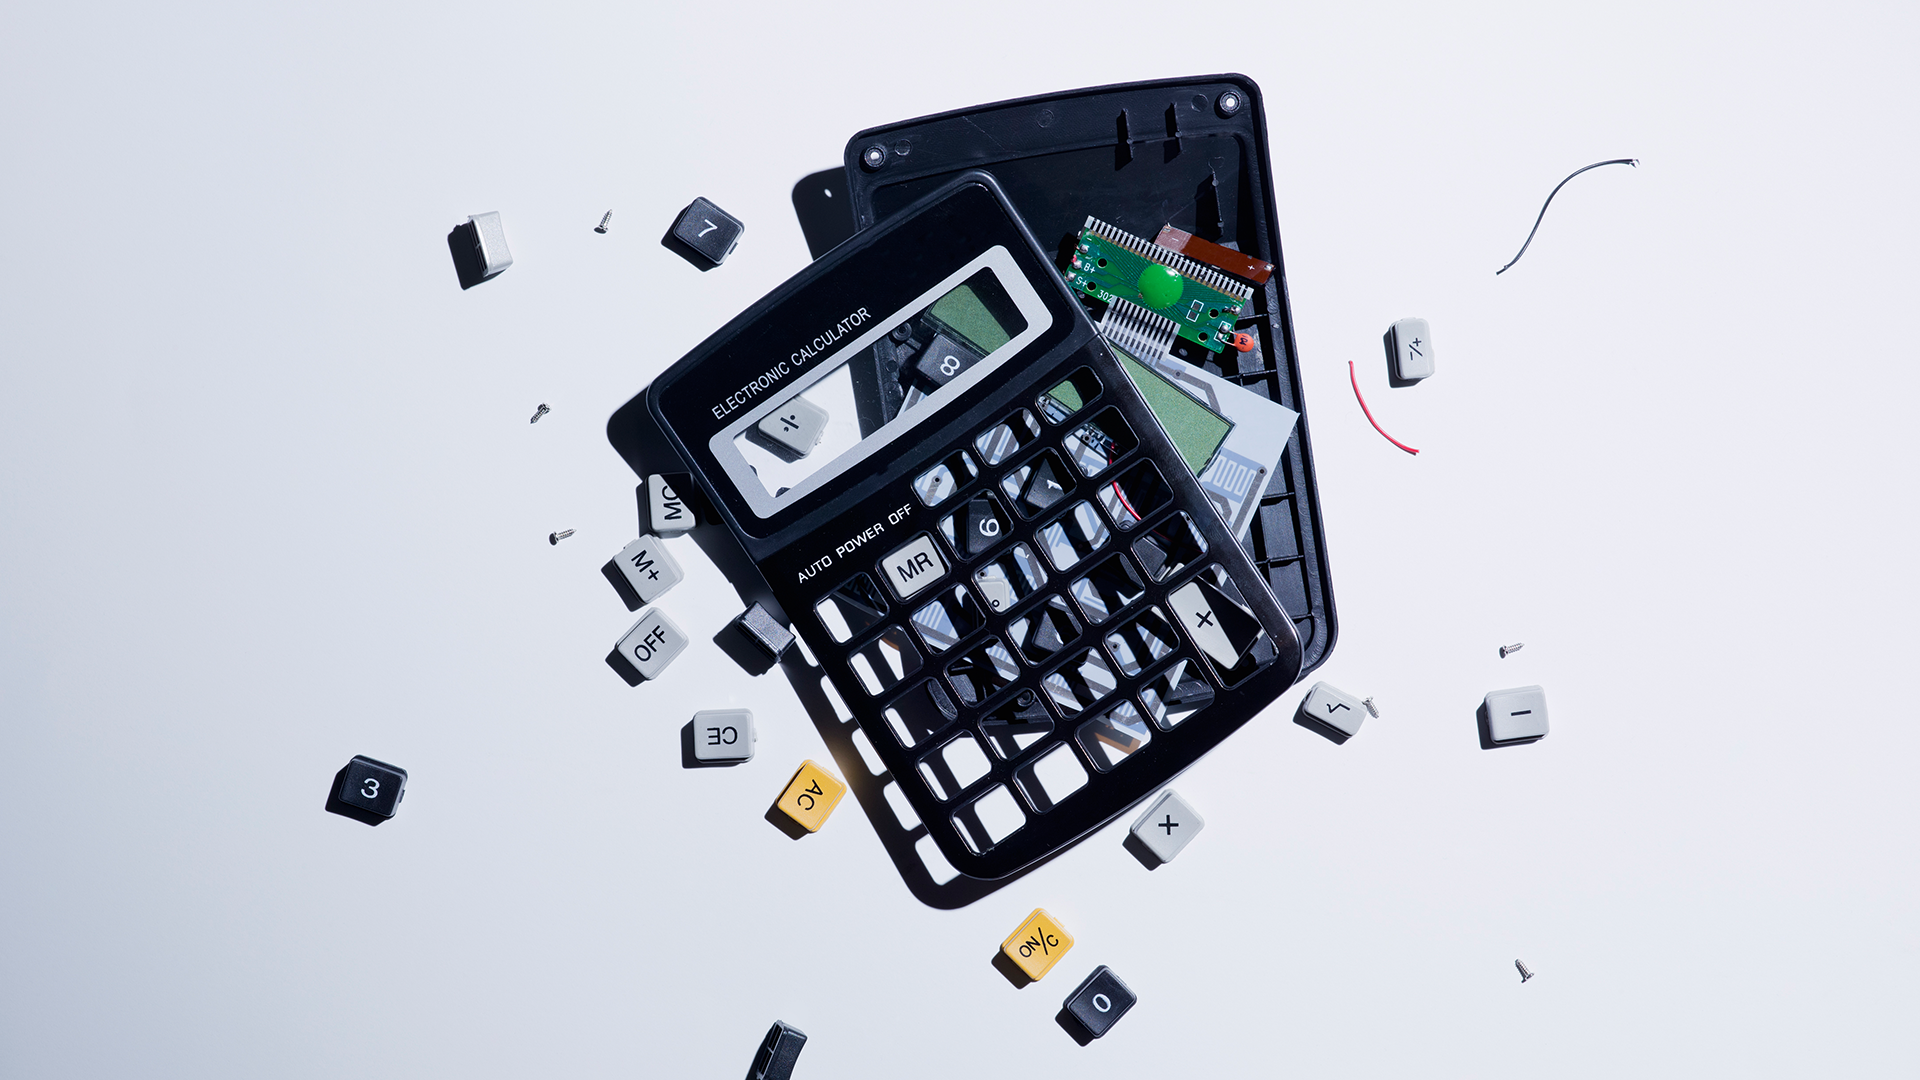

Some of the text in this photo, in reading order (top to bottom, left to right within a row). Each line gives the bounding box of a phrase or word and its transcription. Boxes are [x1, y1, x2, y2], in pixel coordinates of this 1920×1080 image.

[698, 219, 718, 238] 7
[711, 307, 872, 420] ELECTRONIC CALCULATOR
[939, 355, 961, 377] 8
[798, 503, 912, 583] AUTO POWER OFF
[630, 550, 660, 581] M+
[896, 552, 934, 583] MR
[634, 625, 668, 662] OFF
[707, 726, 738, 745] CE
[360, 777, 380, 799] 3
[797, 779, 824, 811] AC
[1018, 927, 1059, 958] ON/C
